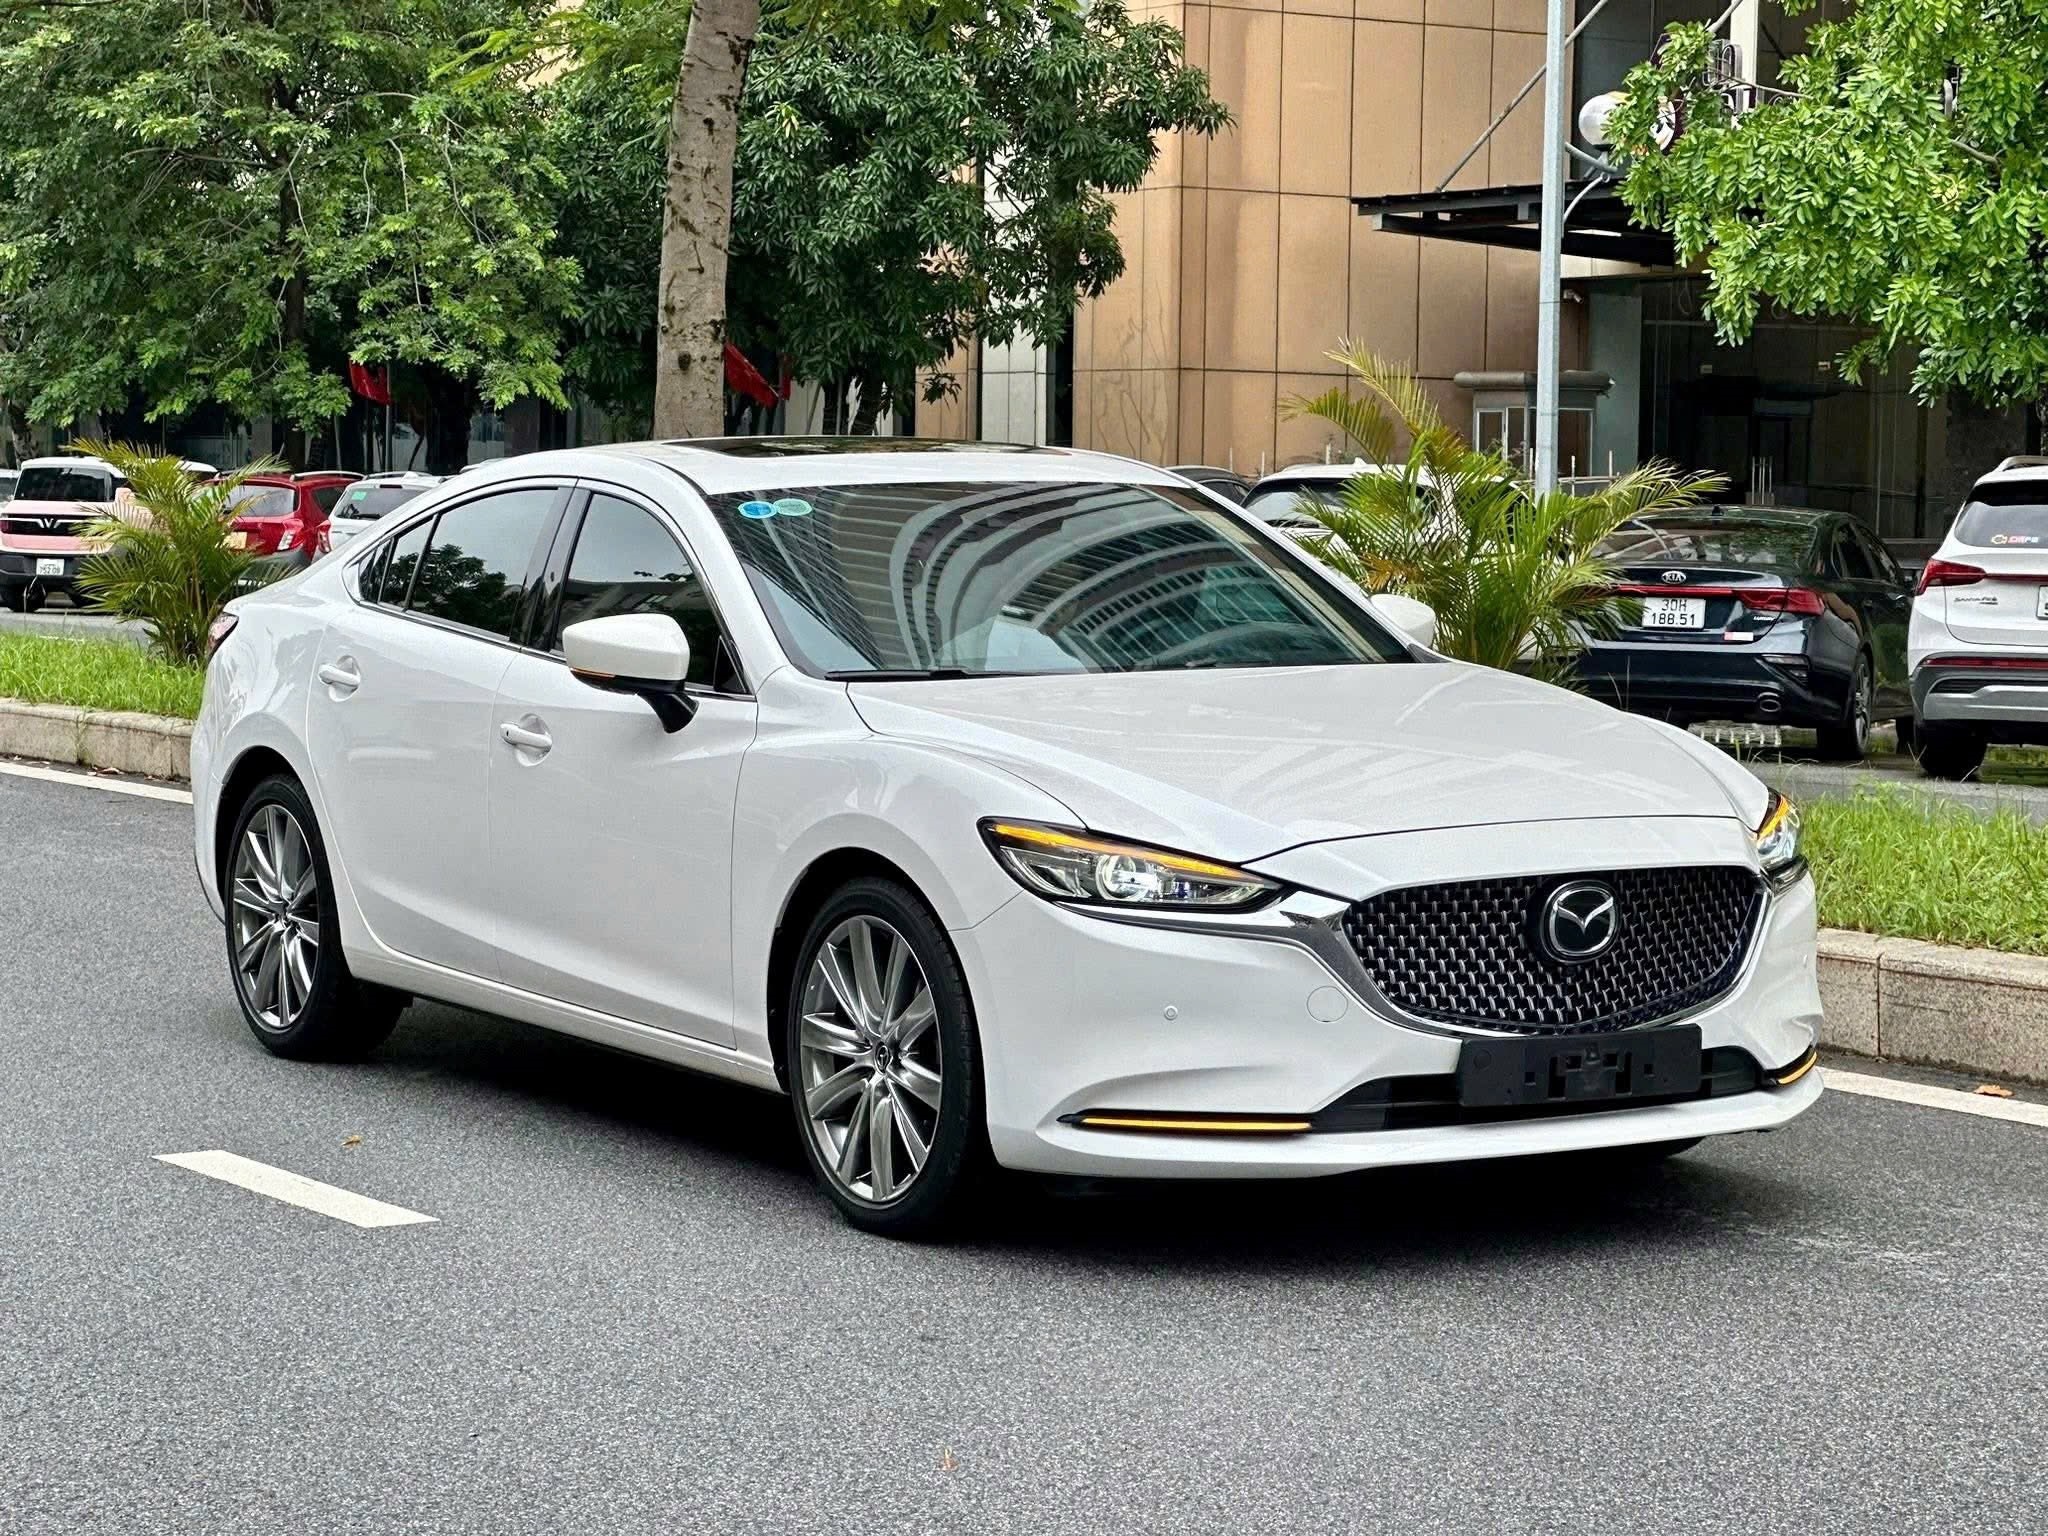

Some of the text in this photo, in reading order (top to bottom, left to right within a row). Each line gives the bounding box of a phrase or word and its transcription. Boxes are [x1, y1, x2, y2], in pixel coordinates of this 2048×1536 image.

[1663, 571, 1684, 582] KIA
[1661, 599, 1687, 612] 30H
[1651, 613, 1696, 626] 188.51
